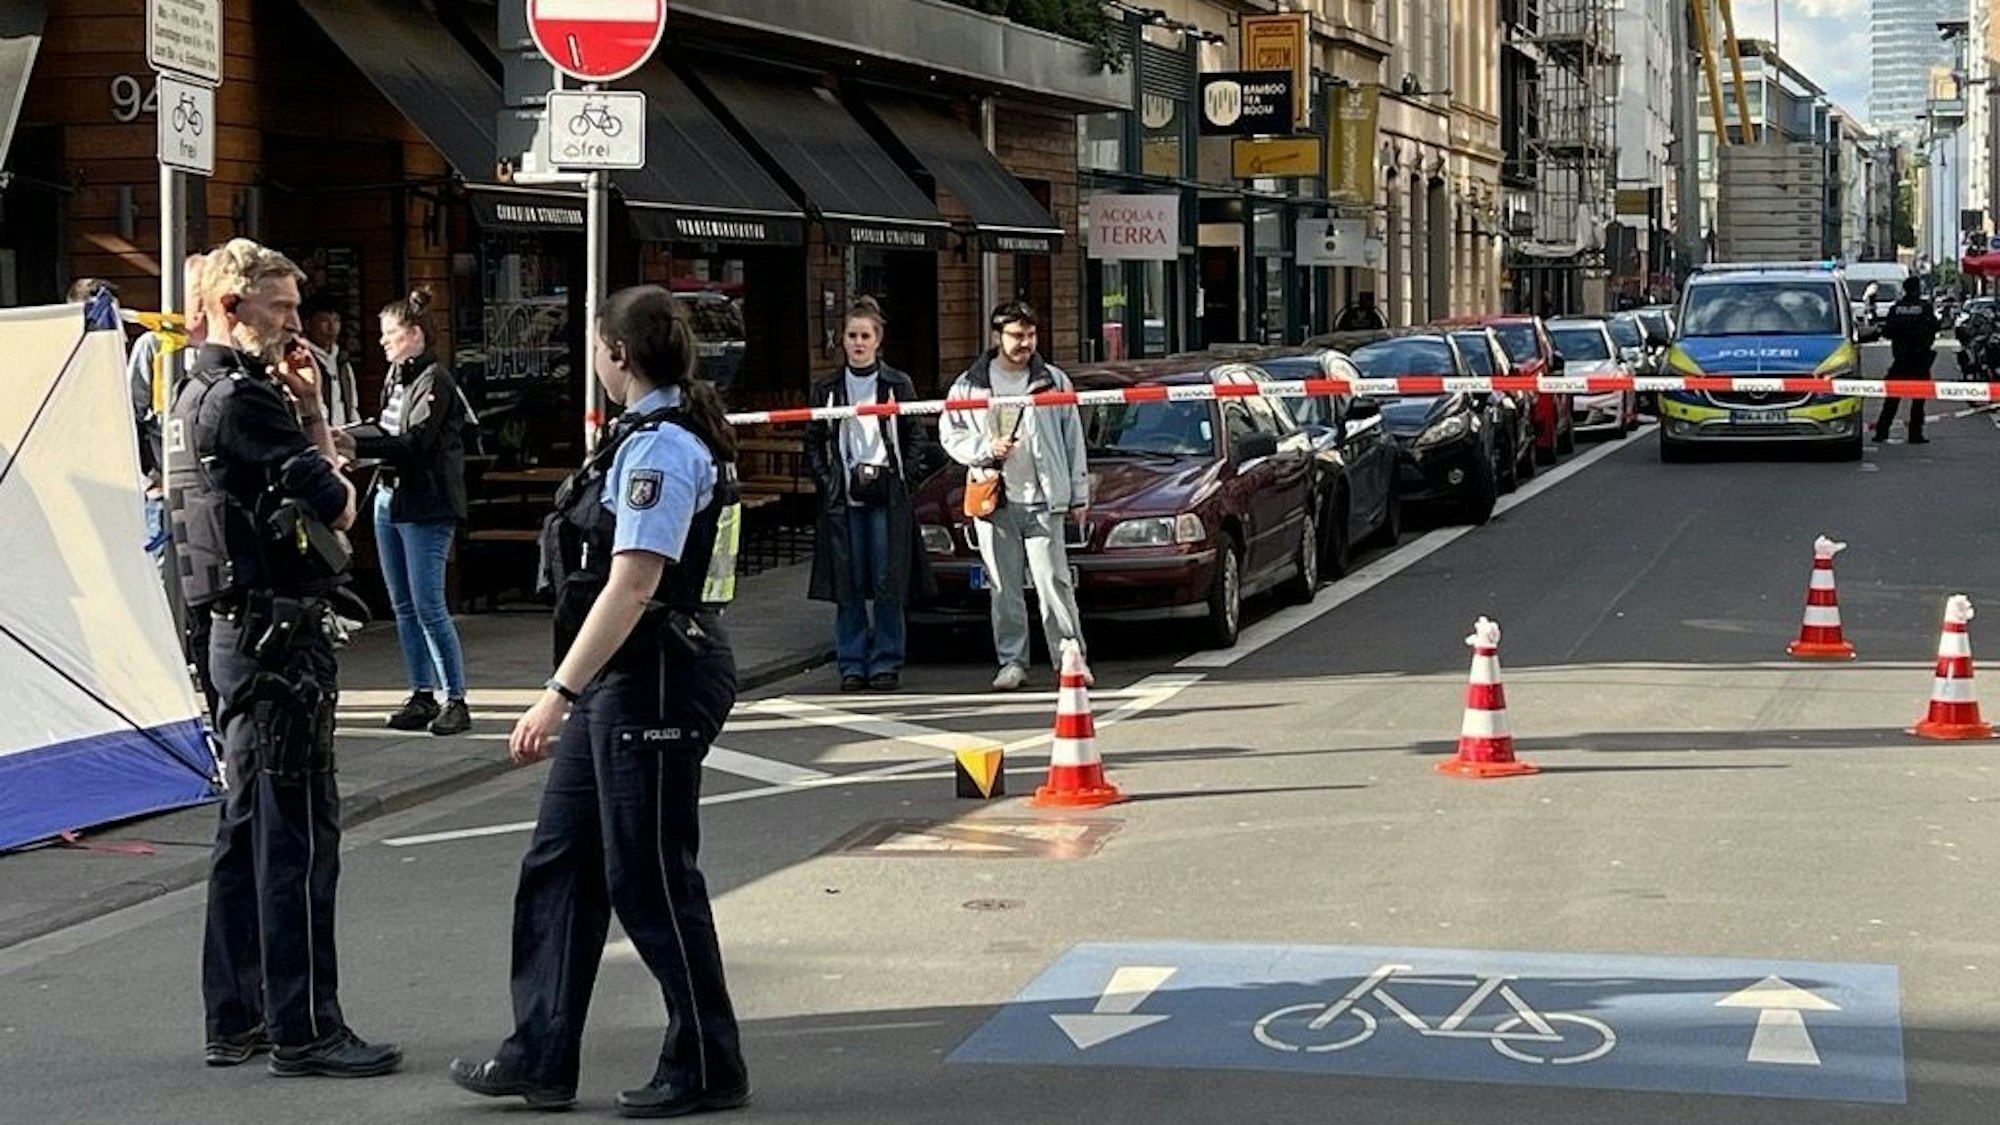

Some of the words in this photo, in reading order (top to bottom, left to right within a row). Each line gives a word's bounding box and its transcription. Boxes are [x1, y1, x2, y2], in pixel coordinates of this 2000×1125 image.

[1243, 83, 1287, 95] BAMBOO
[179, 138, 197, 159] frei
[581, 143, 610, 157] frei
[1100, 208, 1154, 224] ACQUA
[1100, 225, 1167, 245] TERRA
[1718, 348, 1799, 358] POLIZEI
[1939, 387, 1987, 397] POLIZEI
[643, 727, 681, 741] POLIZEI
